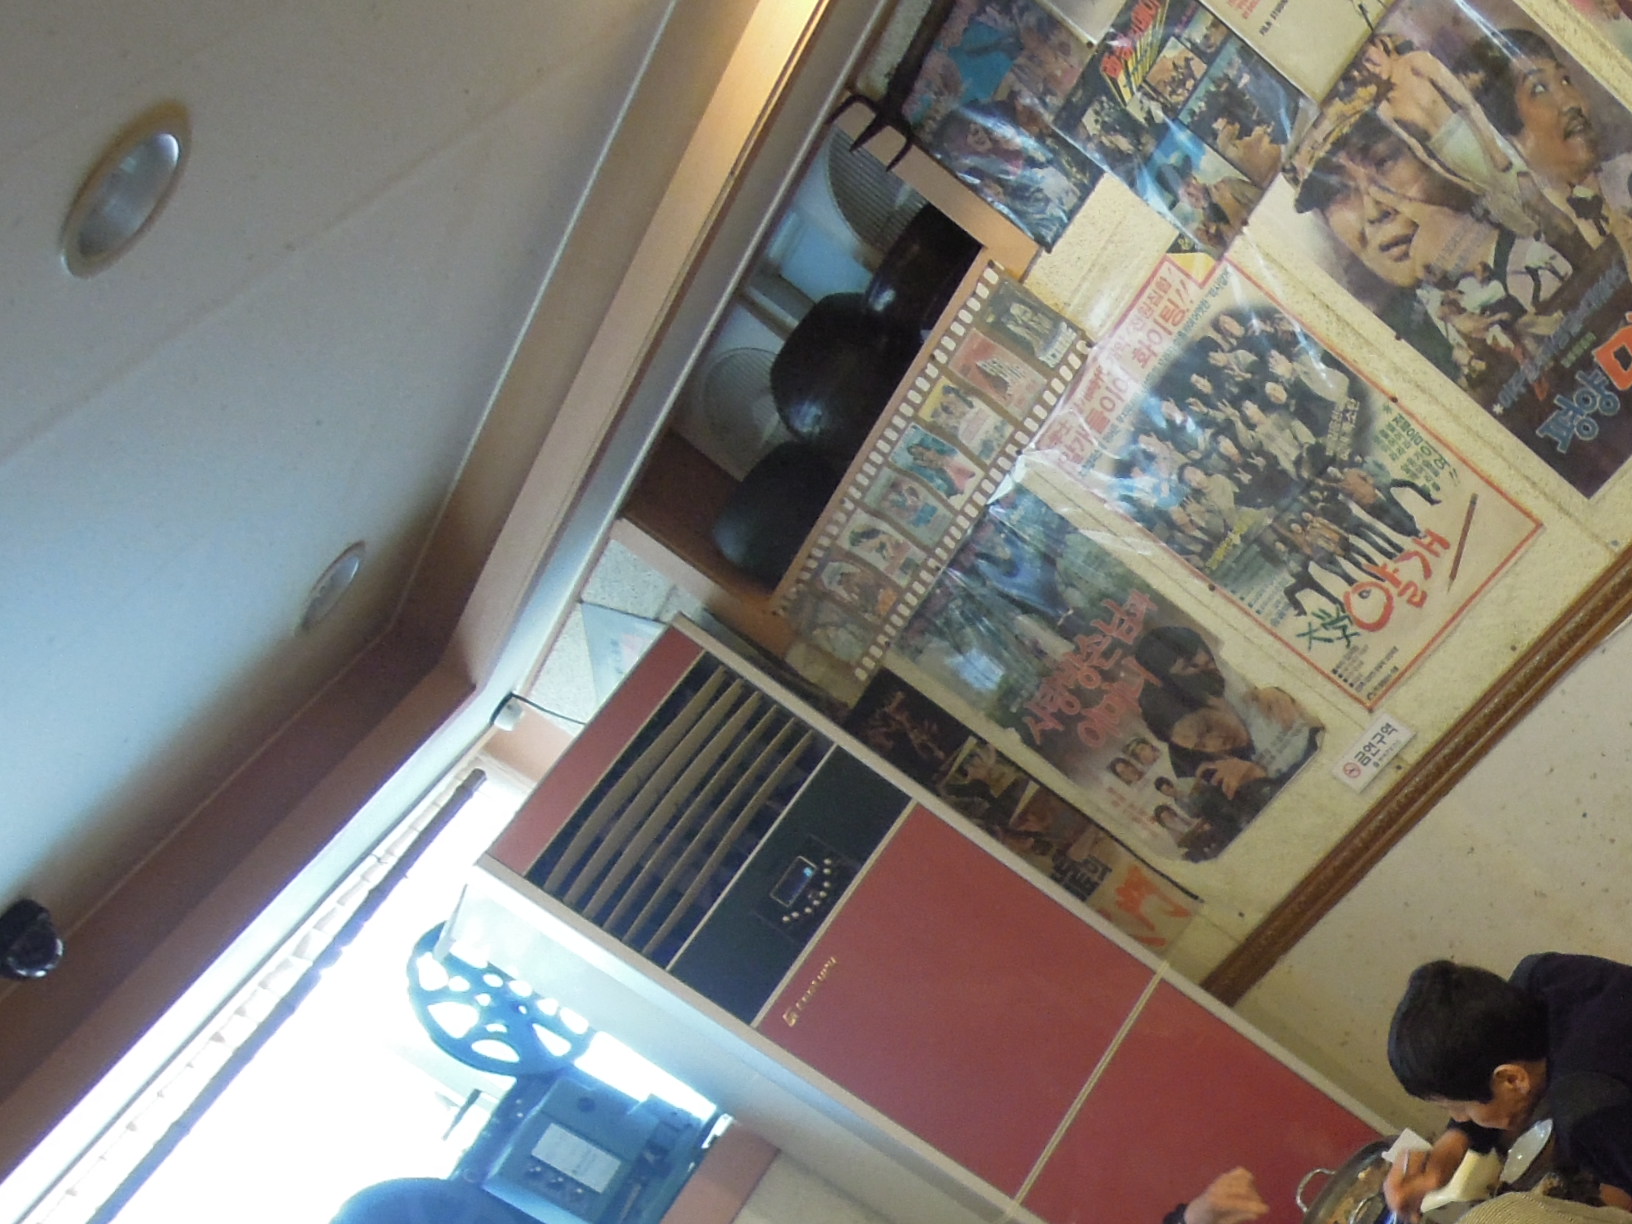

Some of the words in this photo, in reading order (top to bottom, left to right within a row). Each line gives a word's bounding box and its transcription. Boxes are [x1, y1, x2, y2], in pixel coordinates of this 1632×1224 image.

[1129, 279, 1194, 368] 화이팅!!
[1341, 526, 1450, 630] 얄개
[1353, 721, 1398, 767] 금연구역
